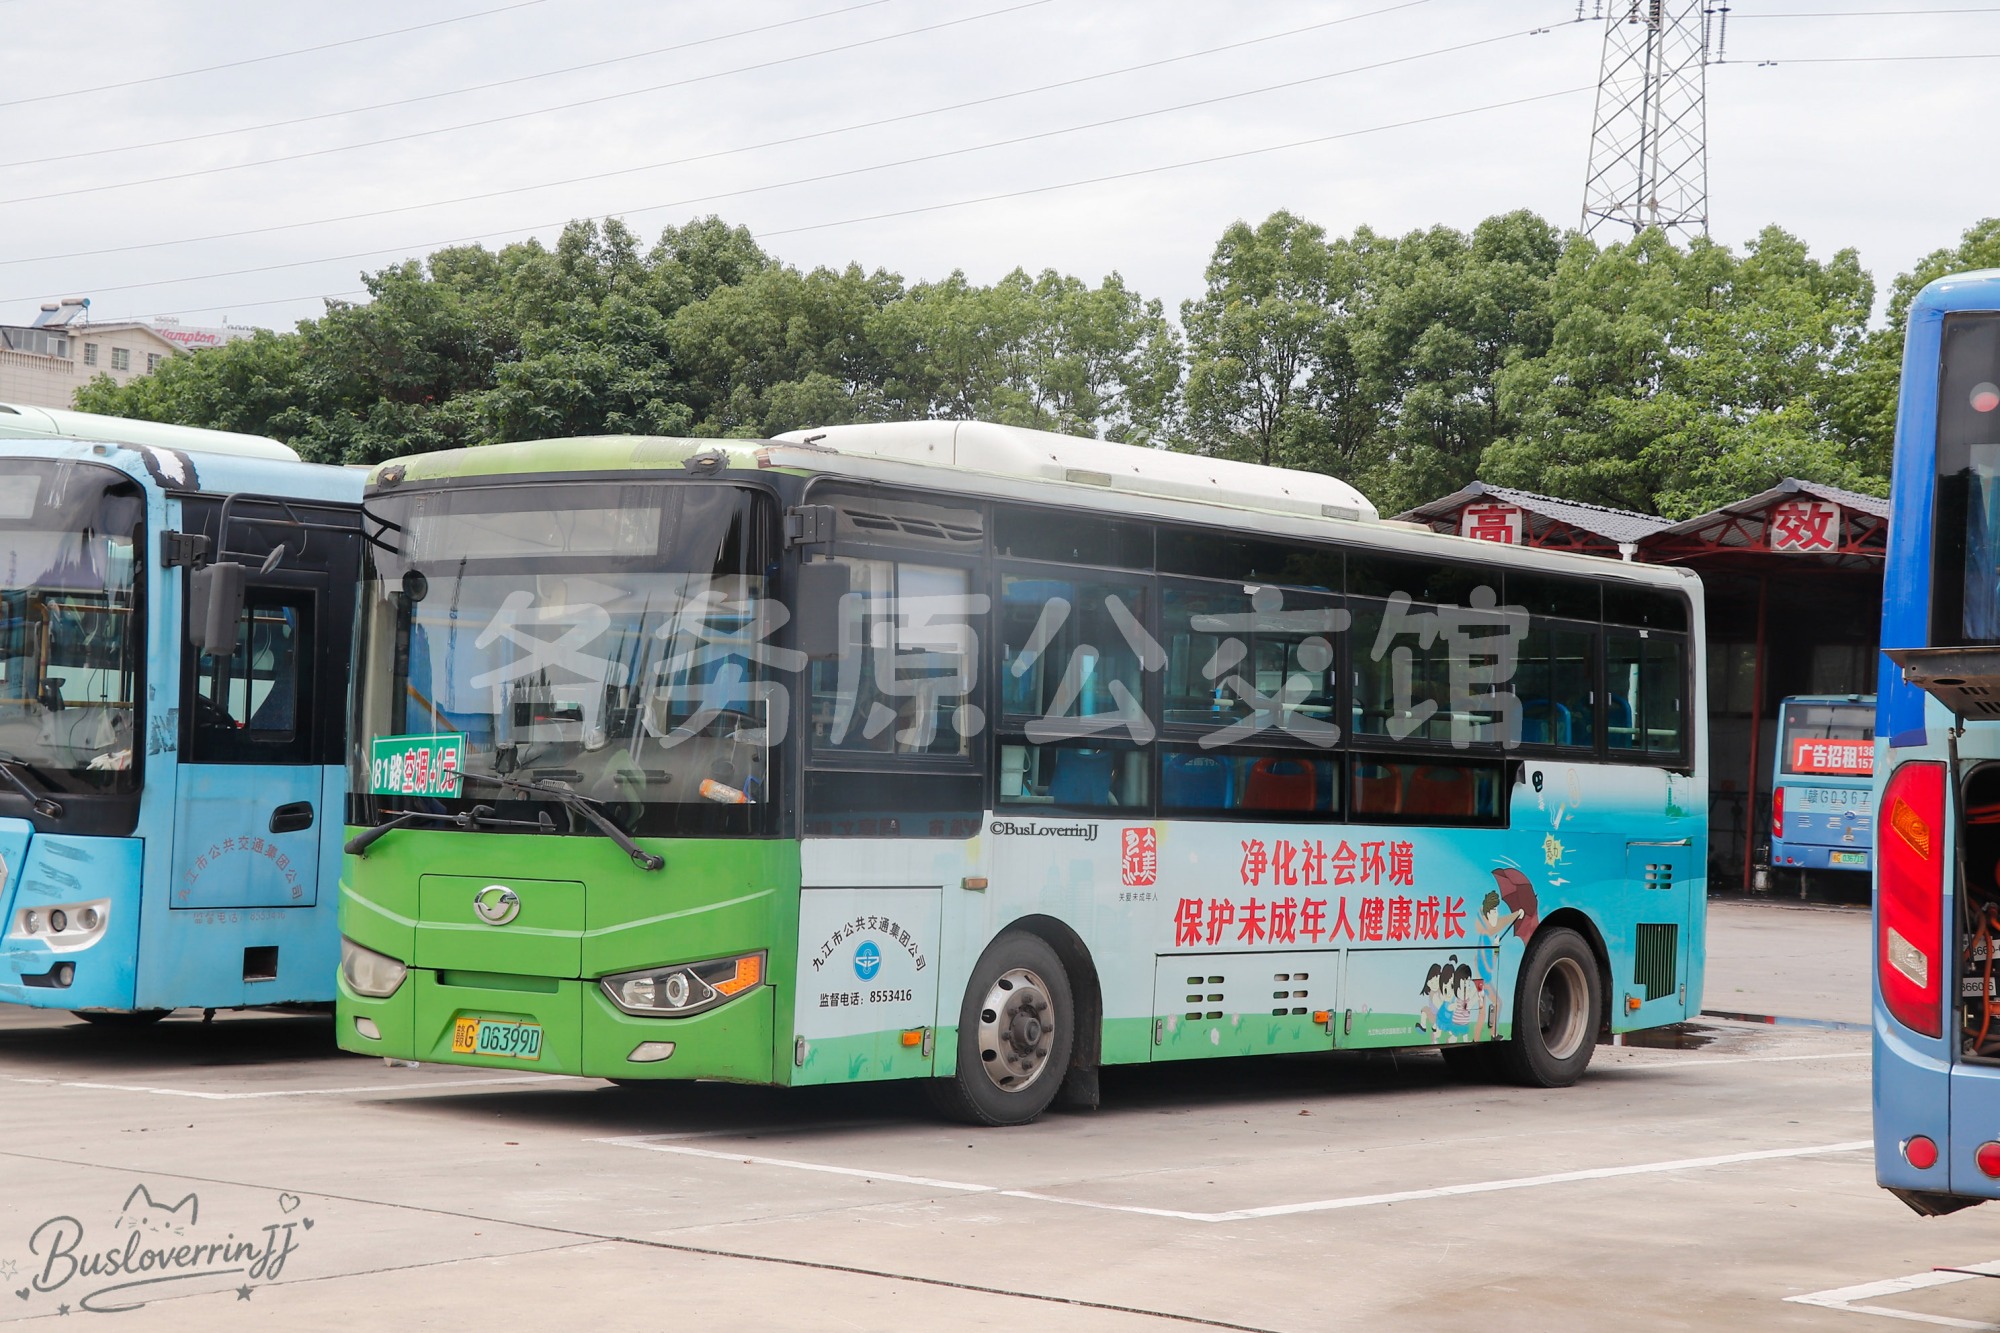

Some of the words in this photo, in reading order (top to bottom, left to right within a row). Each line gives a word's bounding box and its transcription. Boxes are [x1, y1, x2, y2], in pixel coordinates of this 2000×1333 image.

[1468, 505, 1517, 544] 高
[1776, 503, 1834, 549] 效
[1797, 744, 1857, 768] 广告招租
[1240, 839, 1414, 886] 净化社会环境
[812, 915, 926, 971] 九江市公共交通集团公司
[1174, 895, 1467, 947] 保护未成年人健康成长
